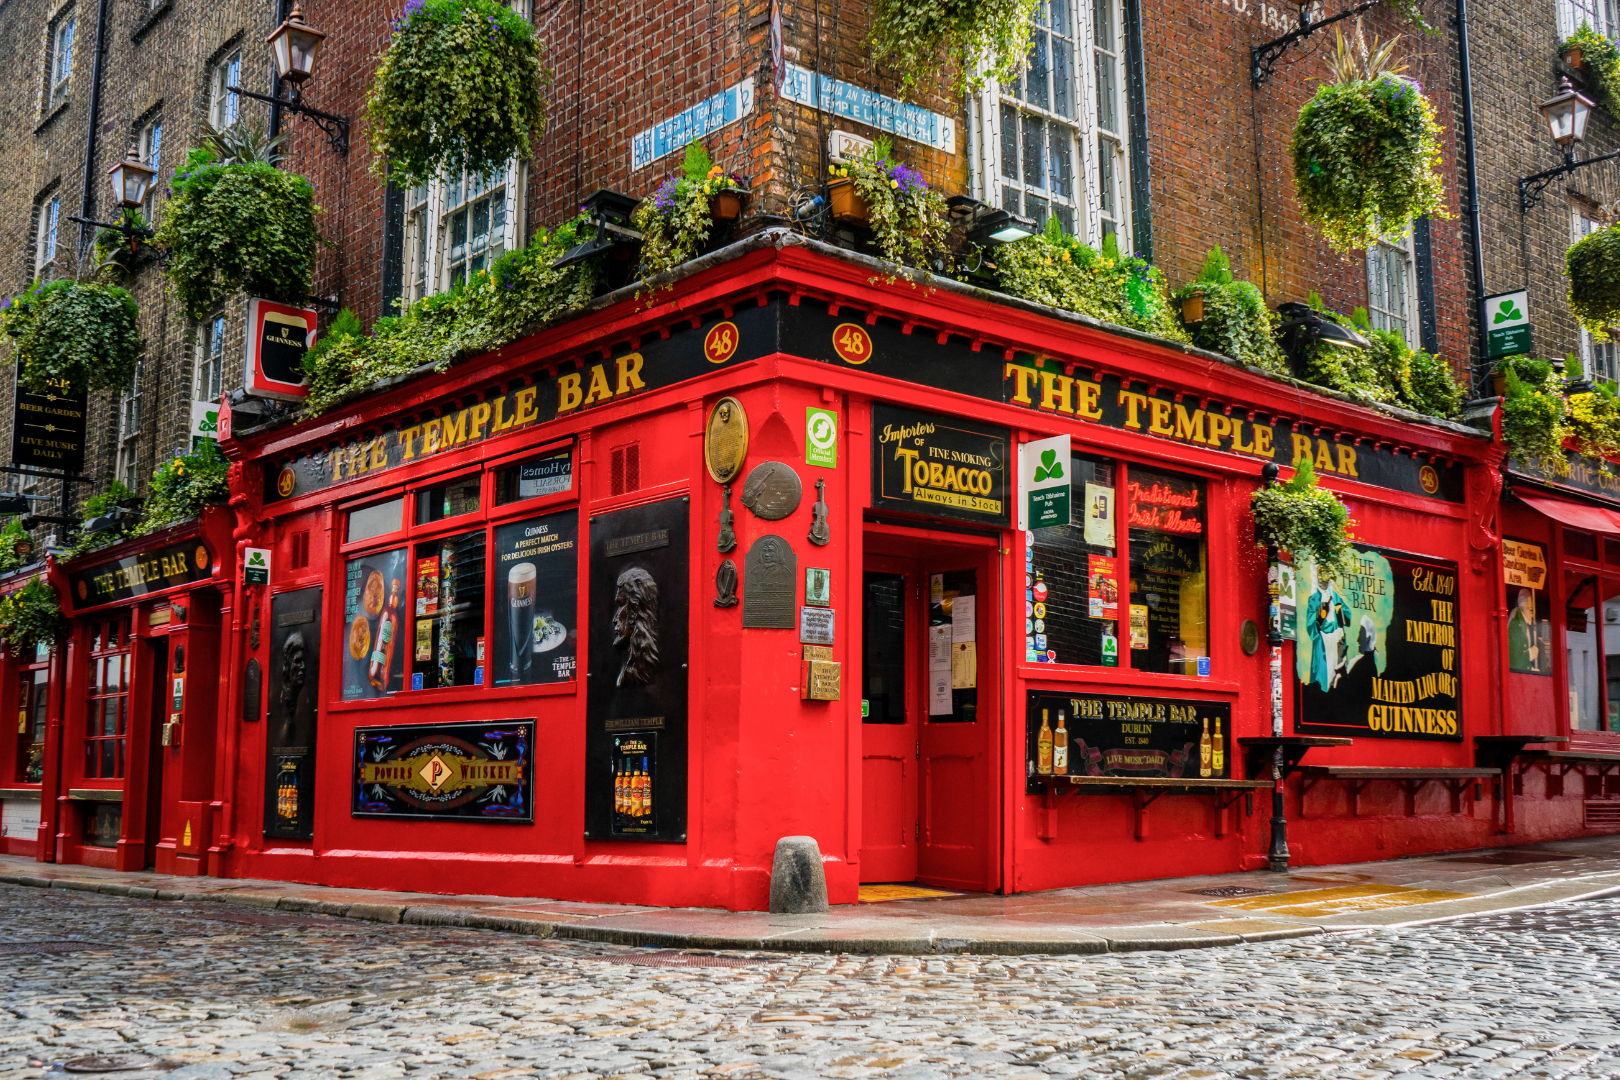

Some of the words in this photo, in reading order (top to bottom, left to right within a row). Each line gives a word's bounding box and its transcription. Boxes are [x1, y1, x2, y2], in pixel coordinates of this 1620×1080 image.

[741, 89, 750, 107] 2
[845, 89, 858, 102] AN
[667, 123, 700, 150] TEMPLE
[704, 113, 724, 132] BAR
[895, 120, 931, 141] SOUTH
[944, 128, 951, 144] 2
[266, 334, 302, 348] GUINNESS
[709, 329, 733, 358] 48
[839, 328, 865, 356] 48
[20, 402, 44, 413] BEER
[45, 407, 82, 418] GARDEN
[327, 436, 388, 484] THE
[399, 385, 539, 462] TEMPLE
[555, 351, 646, 415] BAR
[1006, 363, 1103, 421] THE
[1118, 389, 1276, 459] TEMPLE
[1290, 432, 1359, 478] BAR
[20, 436, 44, 446] LIVE
[45, 440, 78, 451] MUSIC
[879, 421, 935, 449] Importers
[914, 437, 925, 446] OF
[33, 449, 64, 459] DAILY
[811, 452, 833, 463] Member
[813, 447, 831, 456] Official
[929, 446, 950, 460] FINE
[951, 450, 992, 468] SMOKING
[894, 446, 993, 497] TOBACCO
[1422, 471, 1435, 489] 48
[278, 473, 292, 492] 48
[915, 488, 953, 505] Always
[957, 498, 967, 507] in
[971, 496, 1001, 512] Stock
[1033, 494, 1045, 502] Teach
[1128, 481, 1199, 508] Traditional
[1127, 502, 1161, 528] Irish
[1162, 509, 1203, 534] Music
[515, 541, 519, 549] A
[519, 536, 541, 549] PERFECT
[541, 533, 559, 544] MATCH
[524, 524, 549, 537] GUINNESS
[605, 539, 620, 551] THE
[621, 532, 650, 548] TEMPLE
[651, 529, 668, 541] BAR
[501, 553, 511, 562] FOR
[511, 548, 537, 561] DELICIOUS
[537, 545, 551, 555] IRISH
[551, 541, 574, 553] OYSTERS
[1142, 542, 1175, 561] TEMPLE
[1177, 548, 1193, 569] BAR
[1516, 545, 1538, 562] Garden
[94, 572, 116, 595] THE
[115, 558, 161, 590] TEMPLE
[160, 551, 189, 579] BAR
[1352, 557, 1375, 577] THE
[1508, 570, 1523, 584] Area
[1341, 572, 1386, 596] TEMPLE
[1436, 574, 1454, 596] 1840
[511, 596, 533, 608] GUINNESS
[1352, 591, 1377, 613] BAR
[1431, 599, 1454, 624] THE
[1406, 619, 1455, 648] EMPEROR
[552, 661, 577, 672] TEMPLE
[1441, 648, 1455, 671] OF
[557, 669, 570, 678] BAR
[1371, 676, 1416, 704] MALTED
[1415, 671, 1458, 701] LIQUORS
[640, 716, 663, 726] TEMPLE
[1070, 698, 1104, 719] THE
[1107, 700, 1166, 722] TEMPLE
[1169, 704, 1198, 724] BAR
[1368, 704, 1458, 736] GUINNESS
[1121, 723, 1152, 734] DUBLIN
[1124, 736, 1137, 745] EST.
[1138, 737, 1149, 746] 1840
[1106, 754, 1123, 765] LIVE
[1124, 754, 1144, 766] MUSIC
[1145, 755, 1166, 766] DAILY
[374, 766, 413, 781] POWERS
[431, 761, 442, 784] P
[460, 764, 511, 780] WHISKEY
